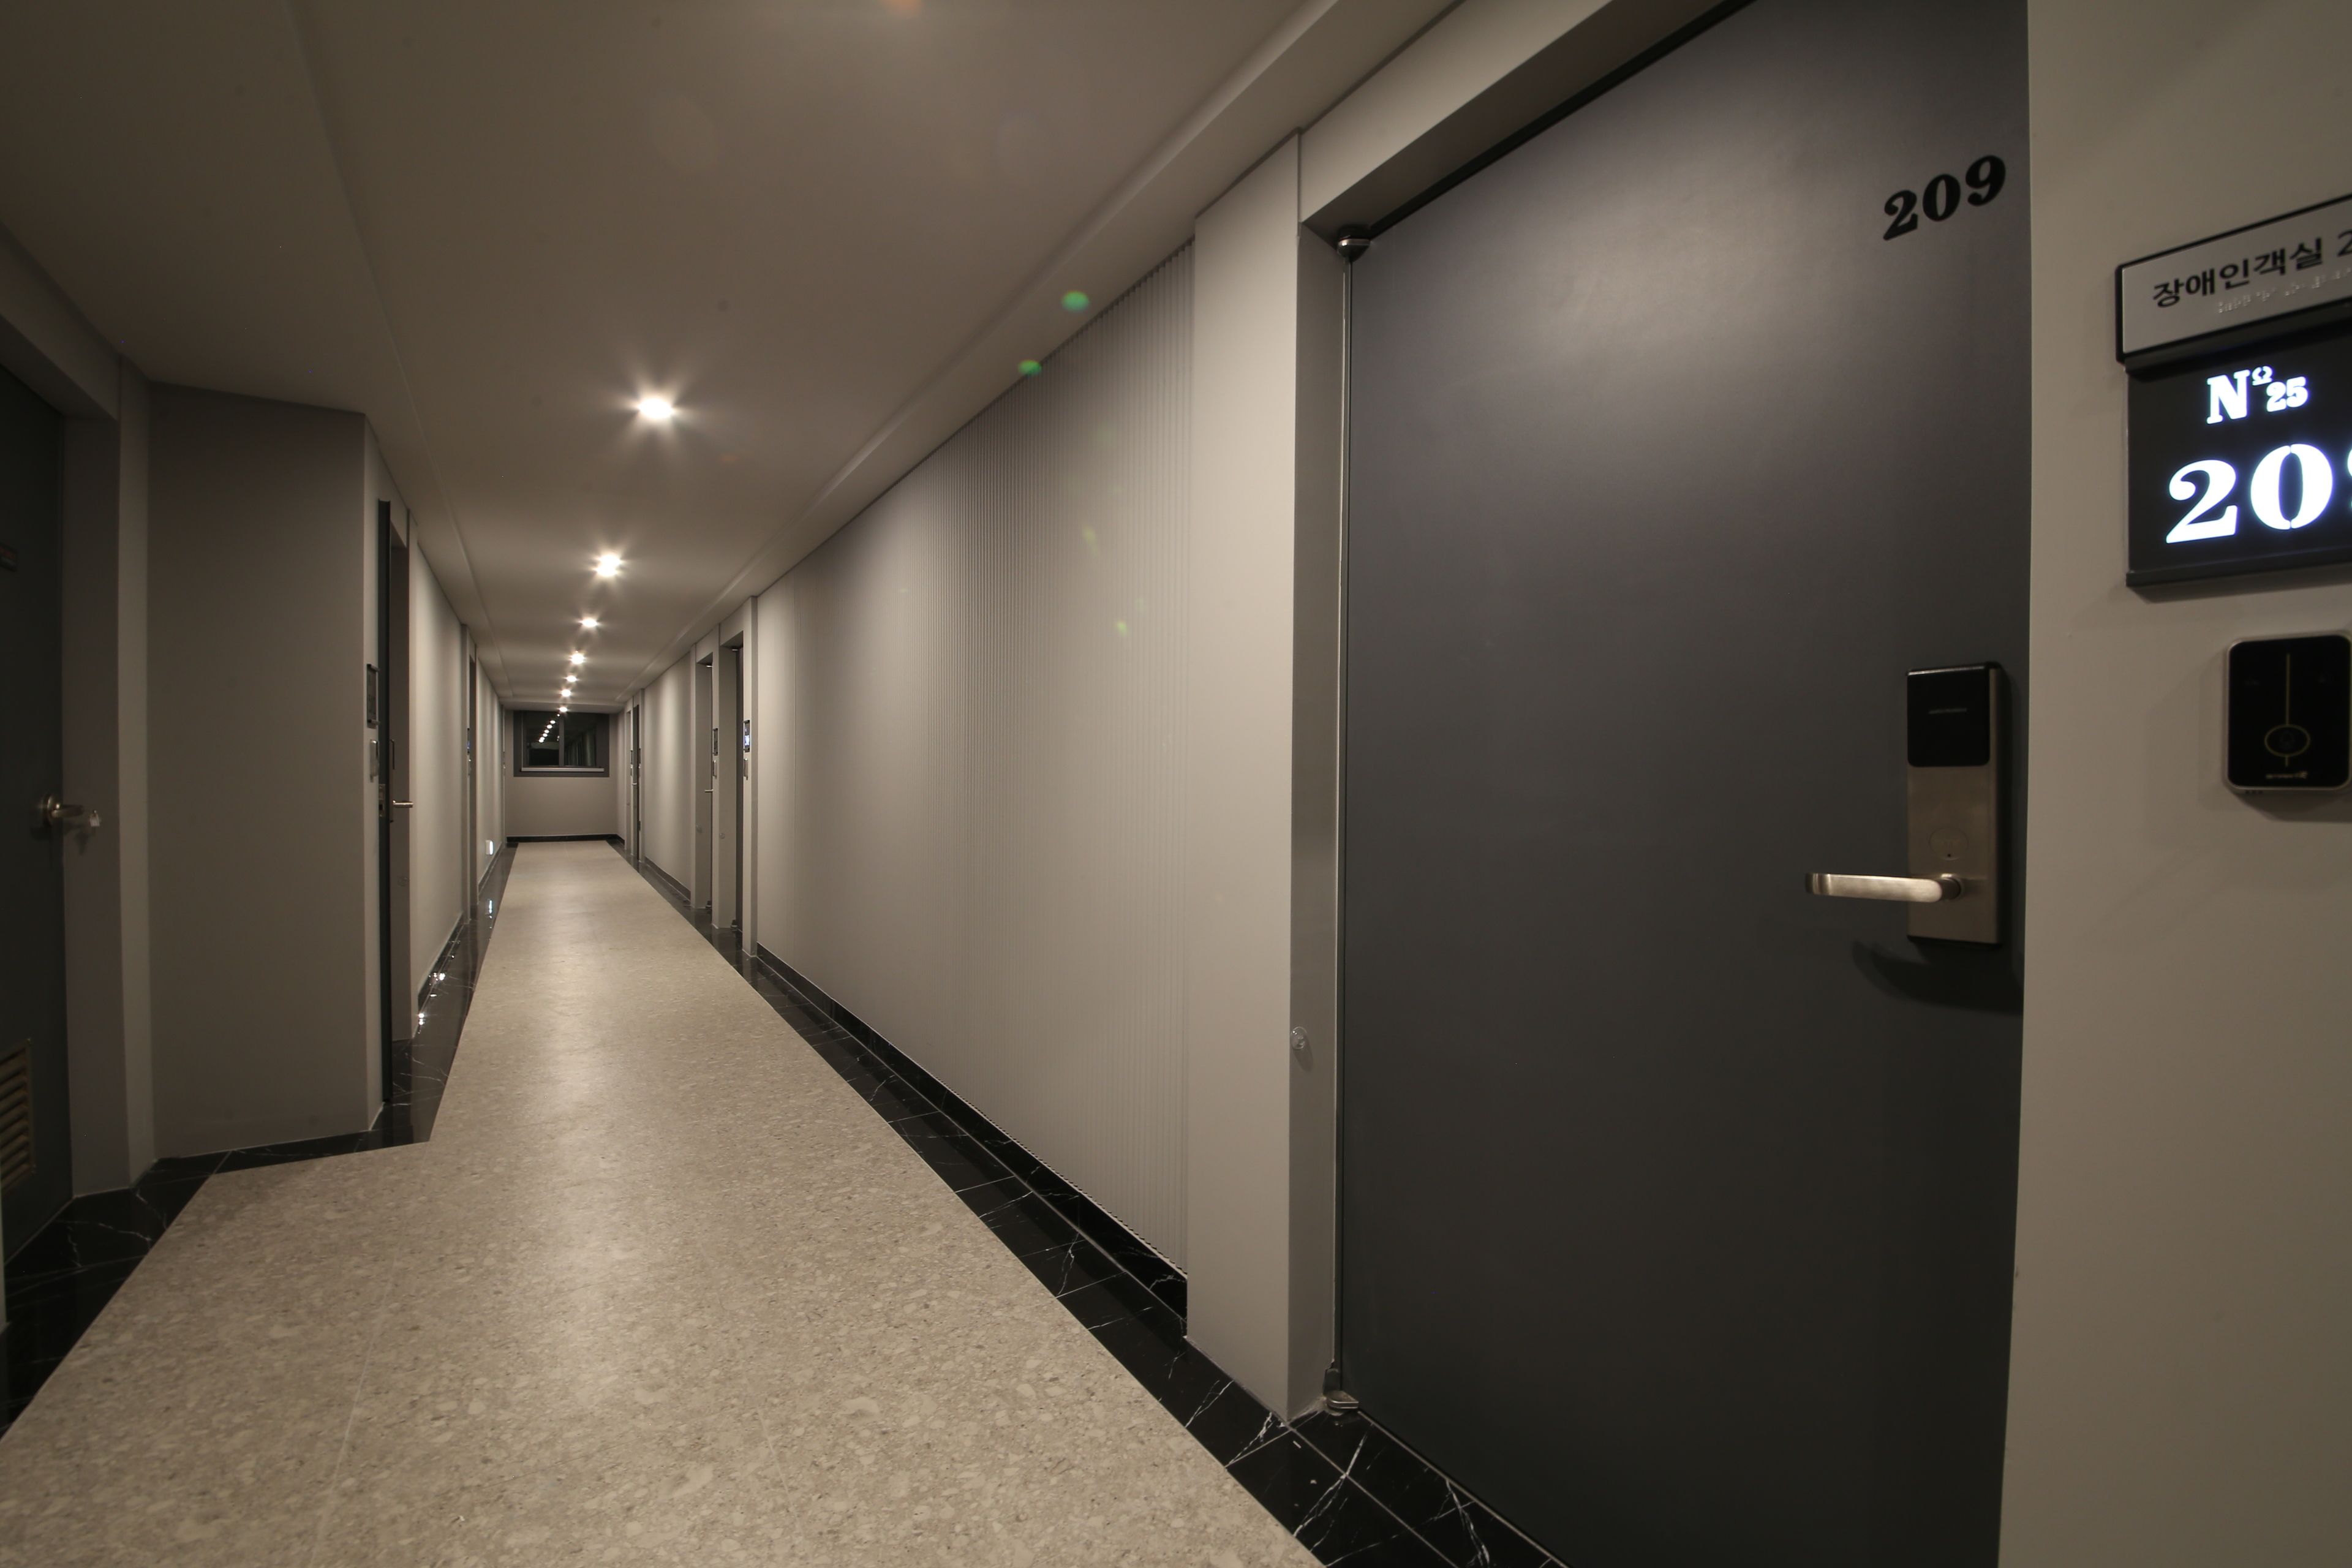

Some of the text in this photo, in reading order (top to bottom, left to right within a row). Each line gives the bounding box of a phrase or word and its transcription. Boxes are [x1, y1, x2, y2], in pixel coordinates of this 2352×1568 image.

[1883, 155, 2006, 241] 209
[2153, 237, 2323, 307] 장애인객실
[2166, 443, 2352, 543] 20
